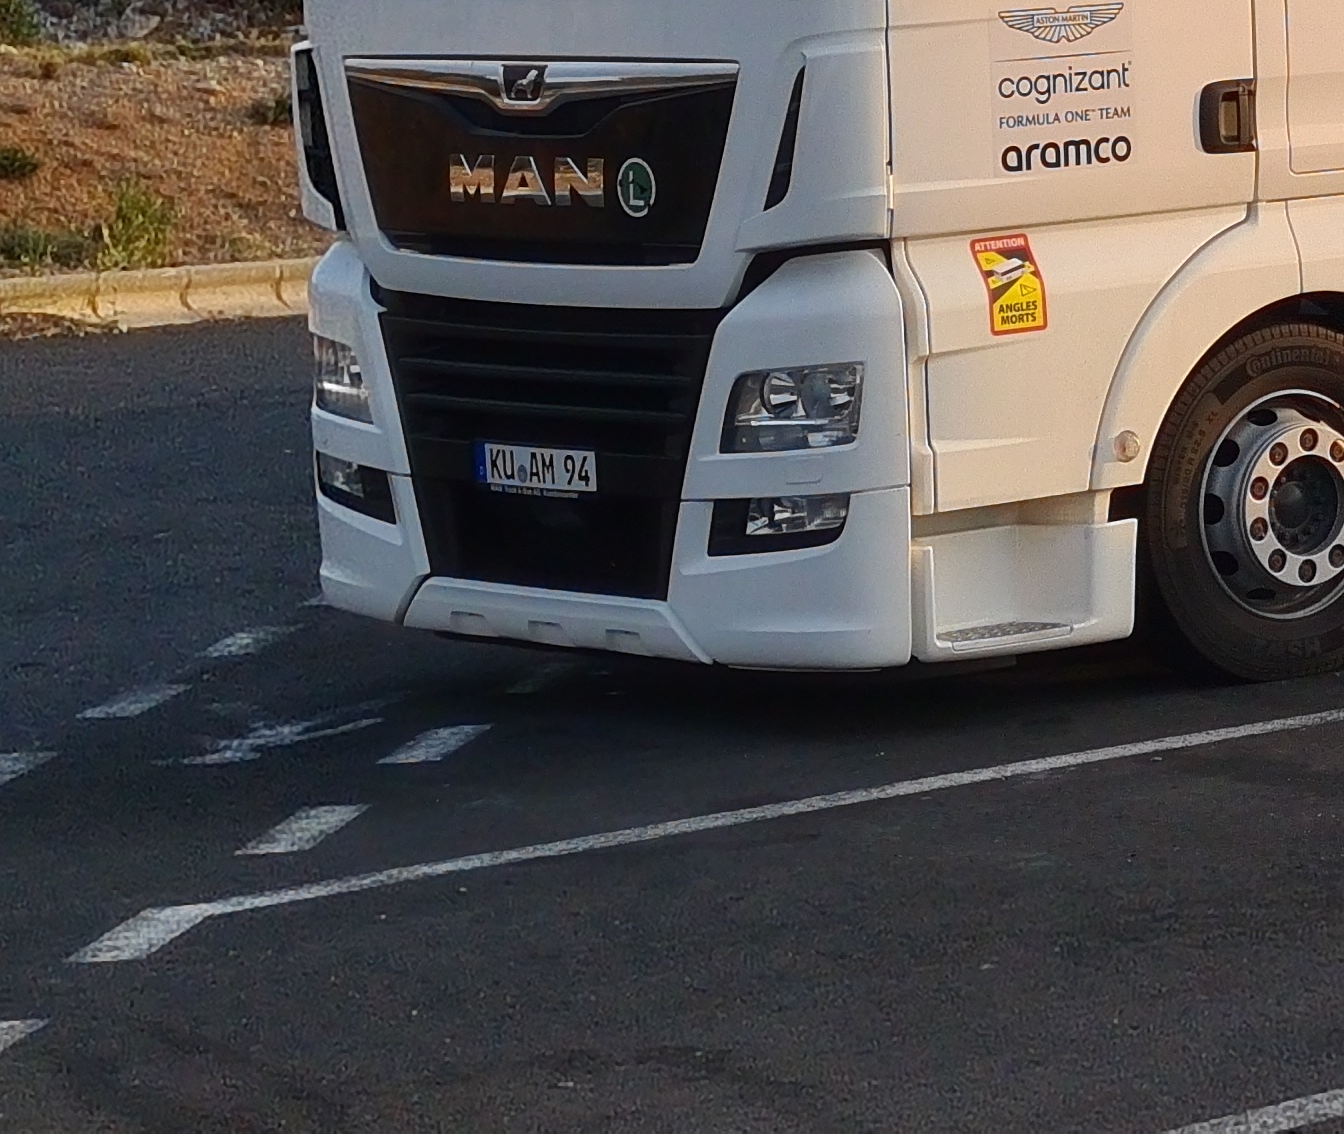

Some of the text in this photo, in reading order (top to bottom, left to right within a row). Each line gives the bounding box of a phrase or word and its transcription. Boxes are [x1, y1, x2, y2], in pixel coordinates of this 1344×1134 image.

[1035, 13, 1089, 25] ASTON MARTIN
[998, 62, 1130, 105] cognizant
[999, 112, 1061, 129] FORMULA
[1098, 106, 1131, 120] TEAM
[1001, 135, 1132, 172] aramco
[449, 153, 605, 208] MAN
[974, 237, 1025, 252] ATTENTION
[998, 300, 1038, 315] ANGLES
[1000, 312, 1037, 326] MORTS
[489, 448, 516, 480] KU
[529, 451, 556, 485] AM
[563, 454, 590, 487] 94
